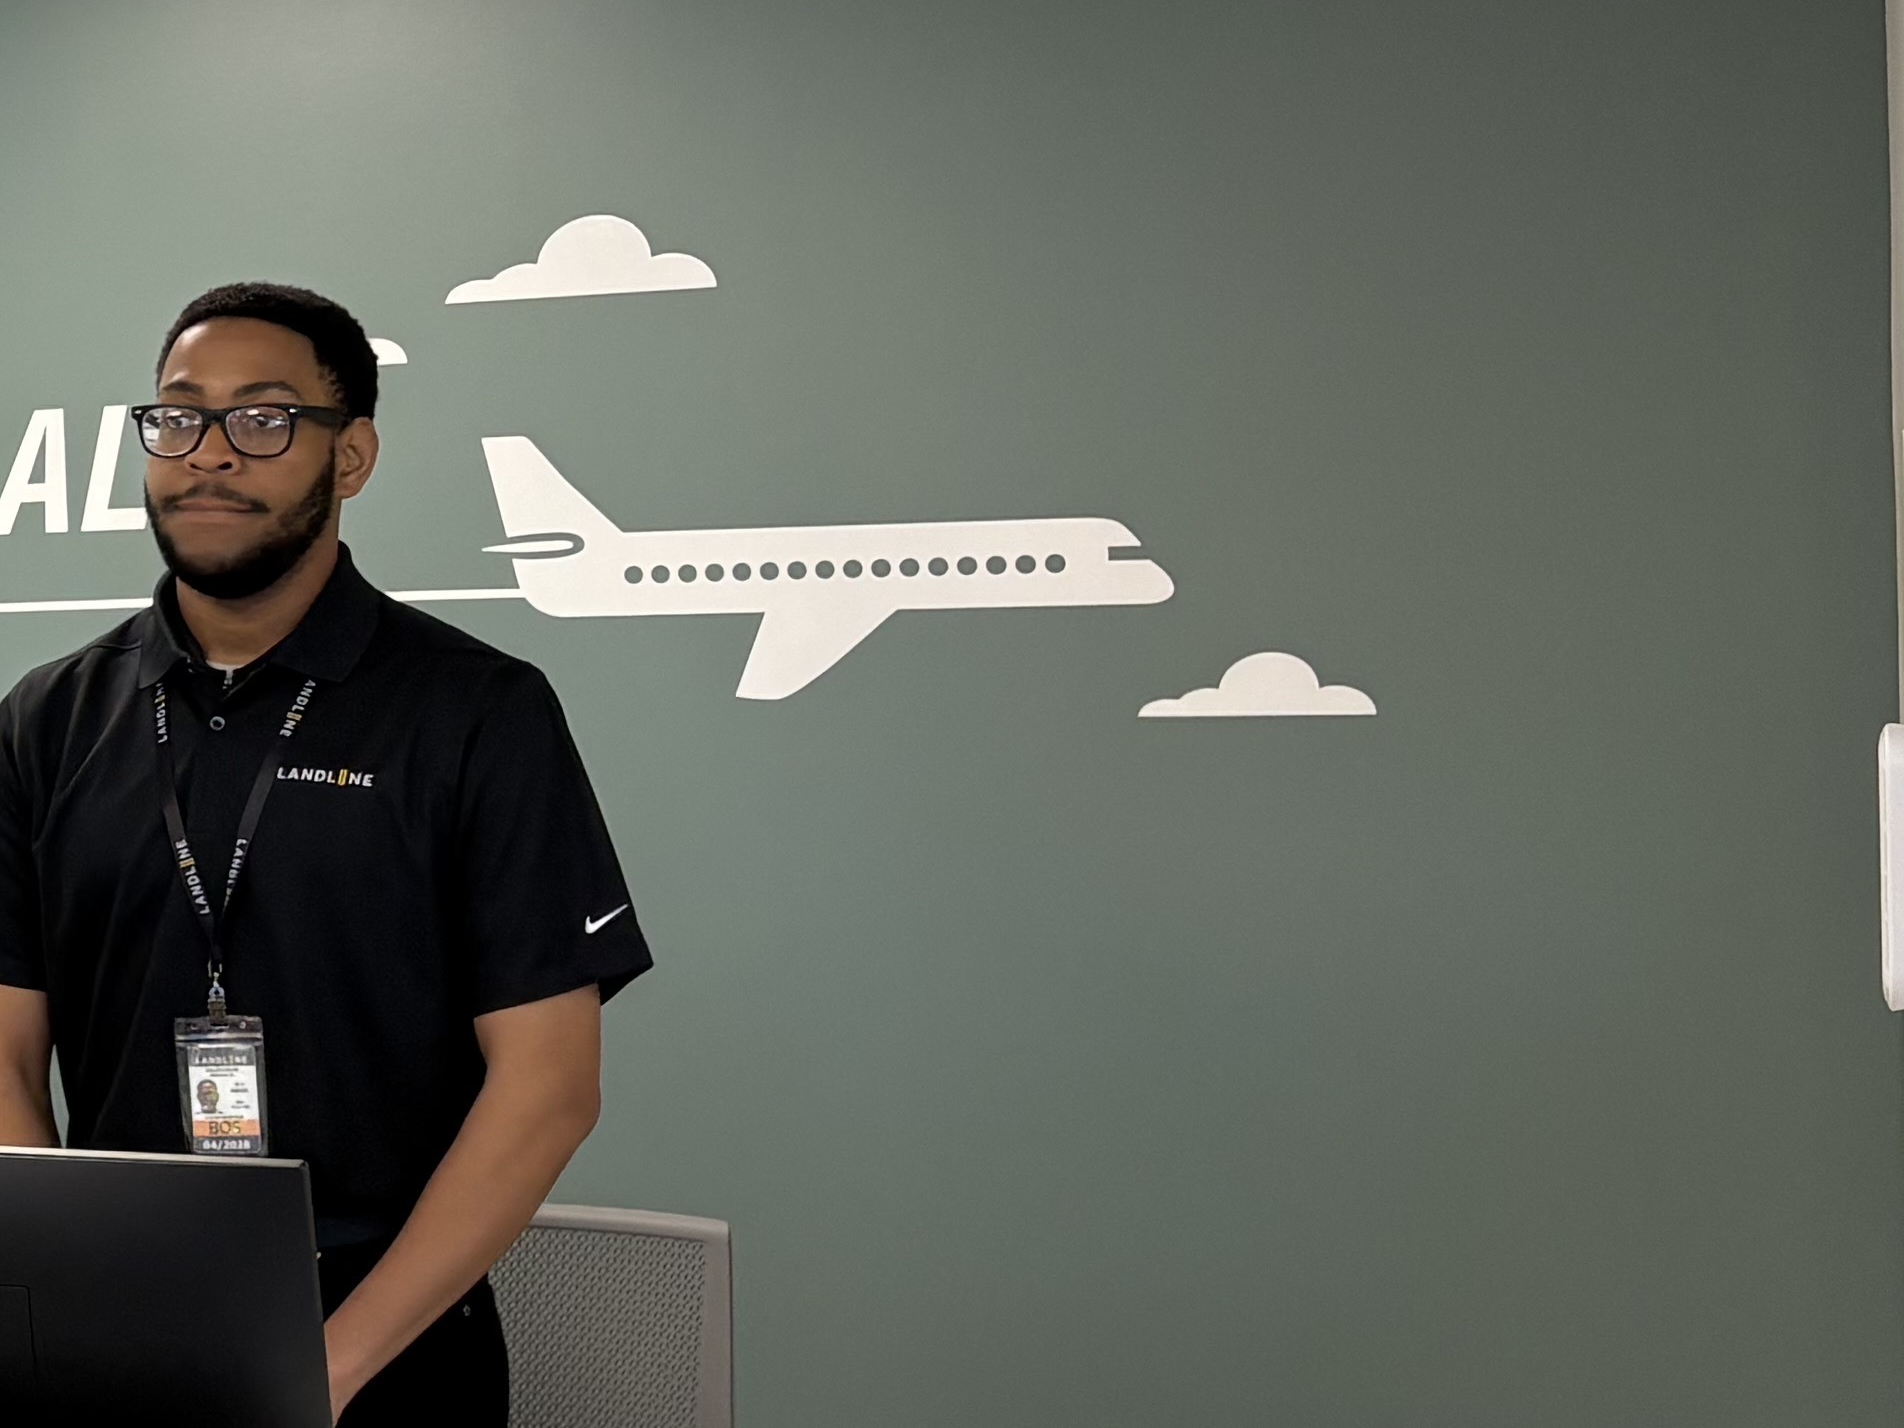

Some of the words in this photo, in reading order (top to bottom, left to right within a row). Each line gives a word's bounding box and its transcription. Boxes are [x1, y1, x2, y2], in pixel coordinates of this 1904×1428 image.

[279, 679, 317, 737] ANDLINE
[277, 766, 374, 787] LANDLINE
[175, 838, 210, 914] LANDLINE
[208, 1120, 242, 1135] BOS
